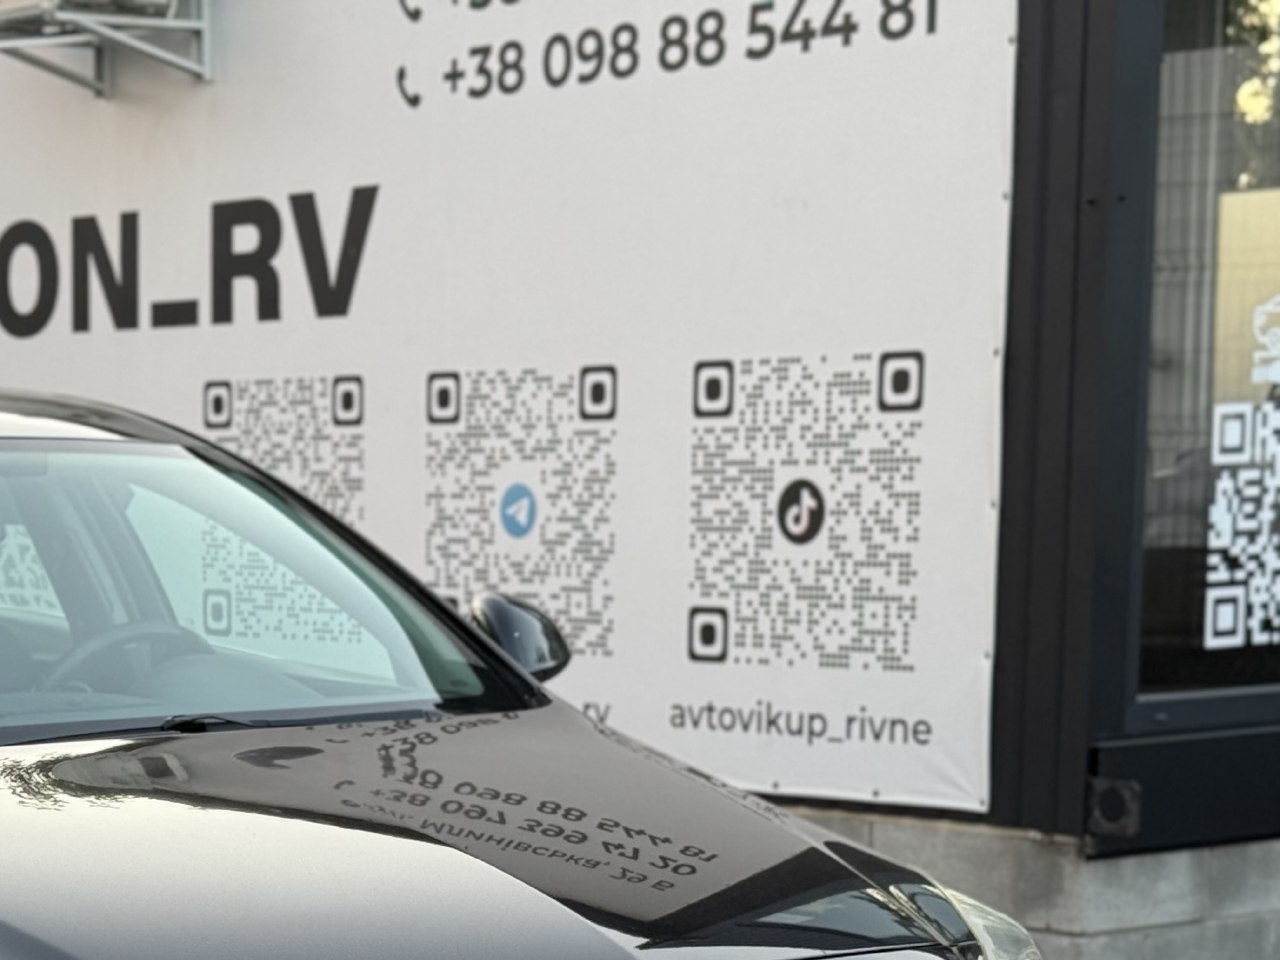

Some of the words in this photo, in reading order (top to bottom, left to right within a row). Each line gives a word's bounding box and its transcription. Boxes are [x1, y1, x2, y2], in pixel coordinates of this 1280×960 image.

[442, 40, 525, 99] +38
[542, 22, 640, 88] 098
[658, 8, 727, 72] 88
[744, 0, 859, 61] 544
[878, 0, 938, 41] 81
[669, 699, 933, 745] avtovikup_rivne
